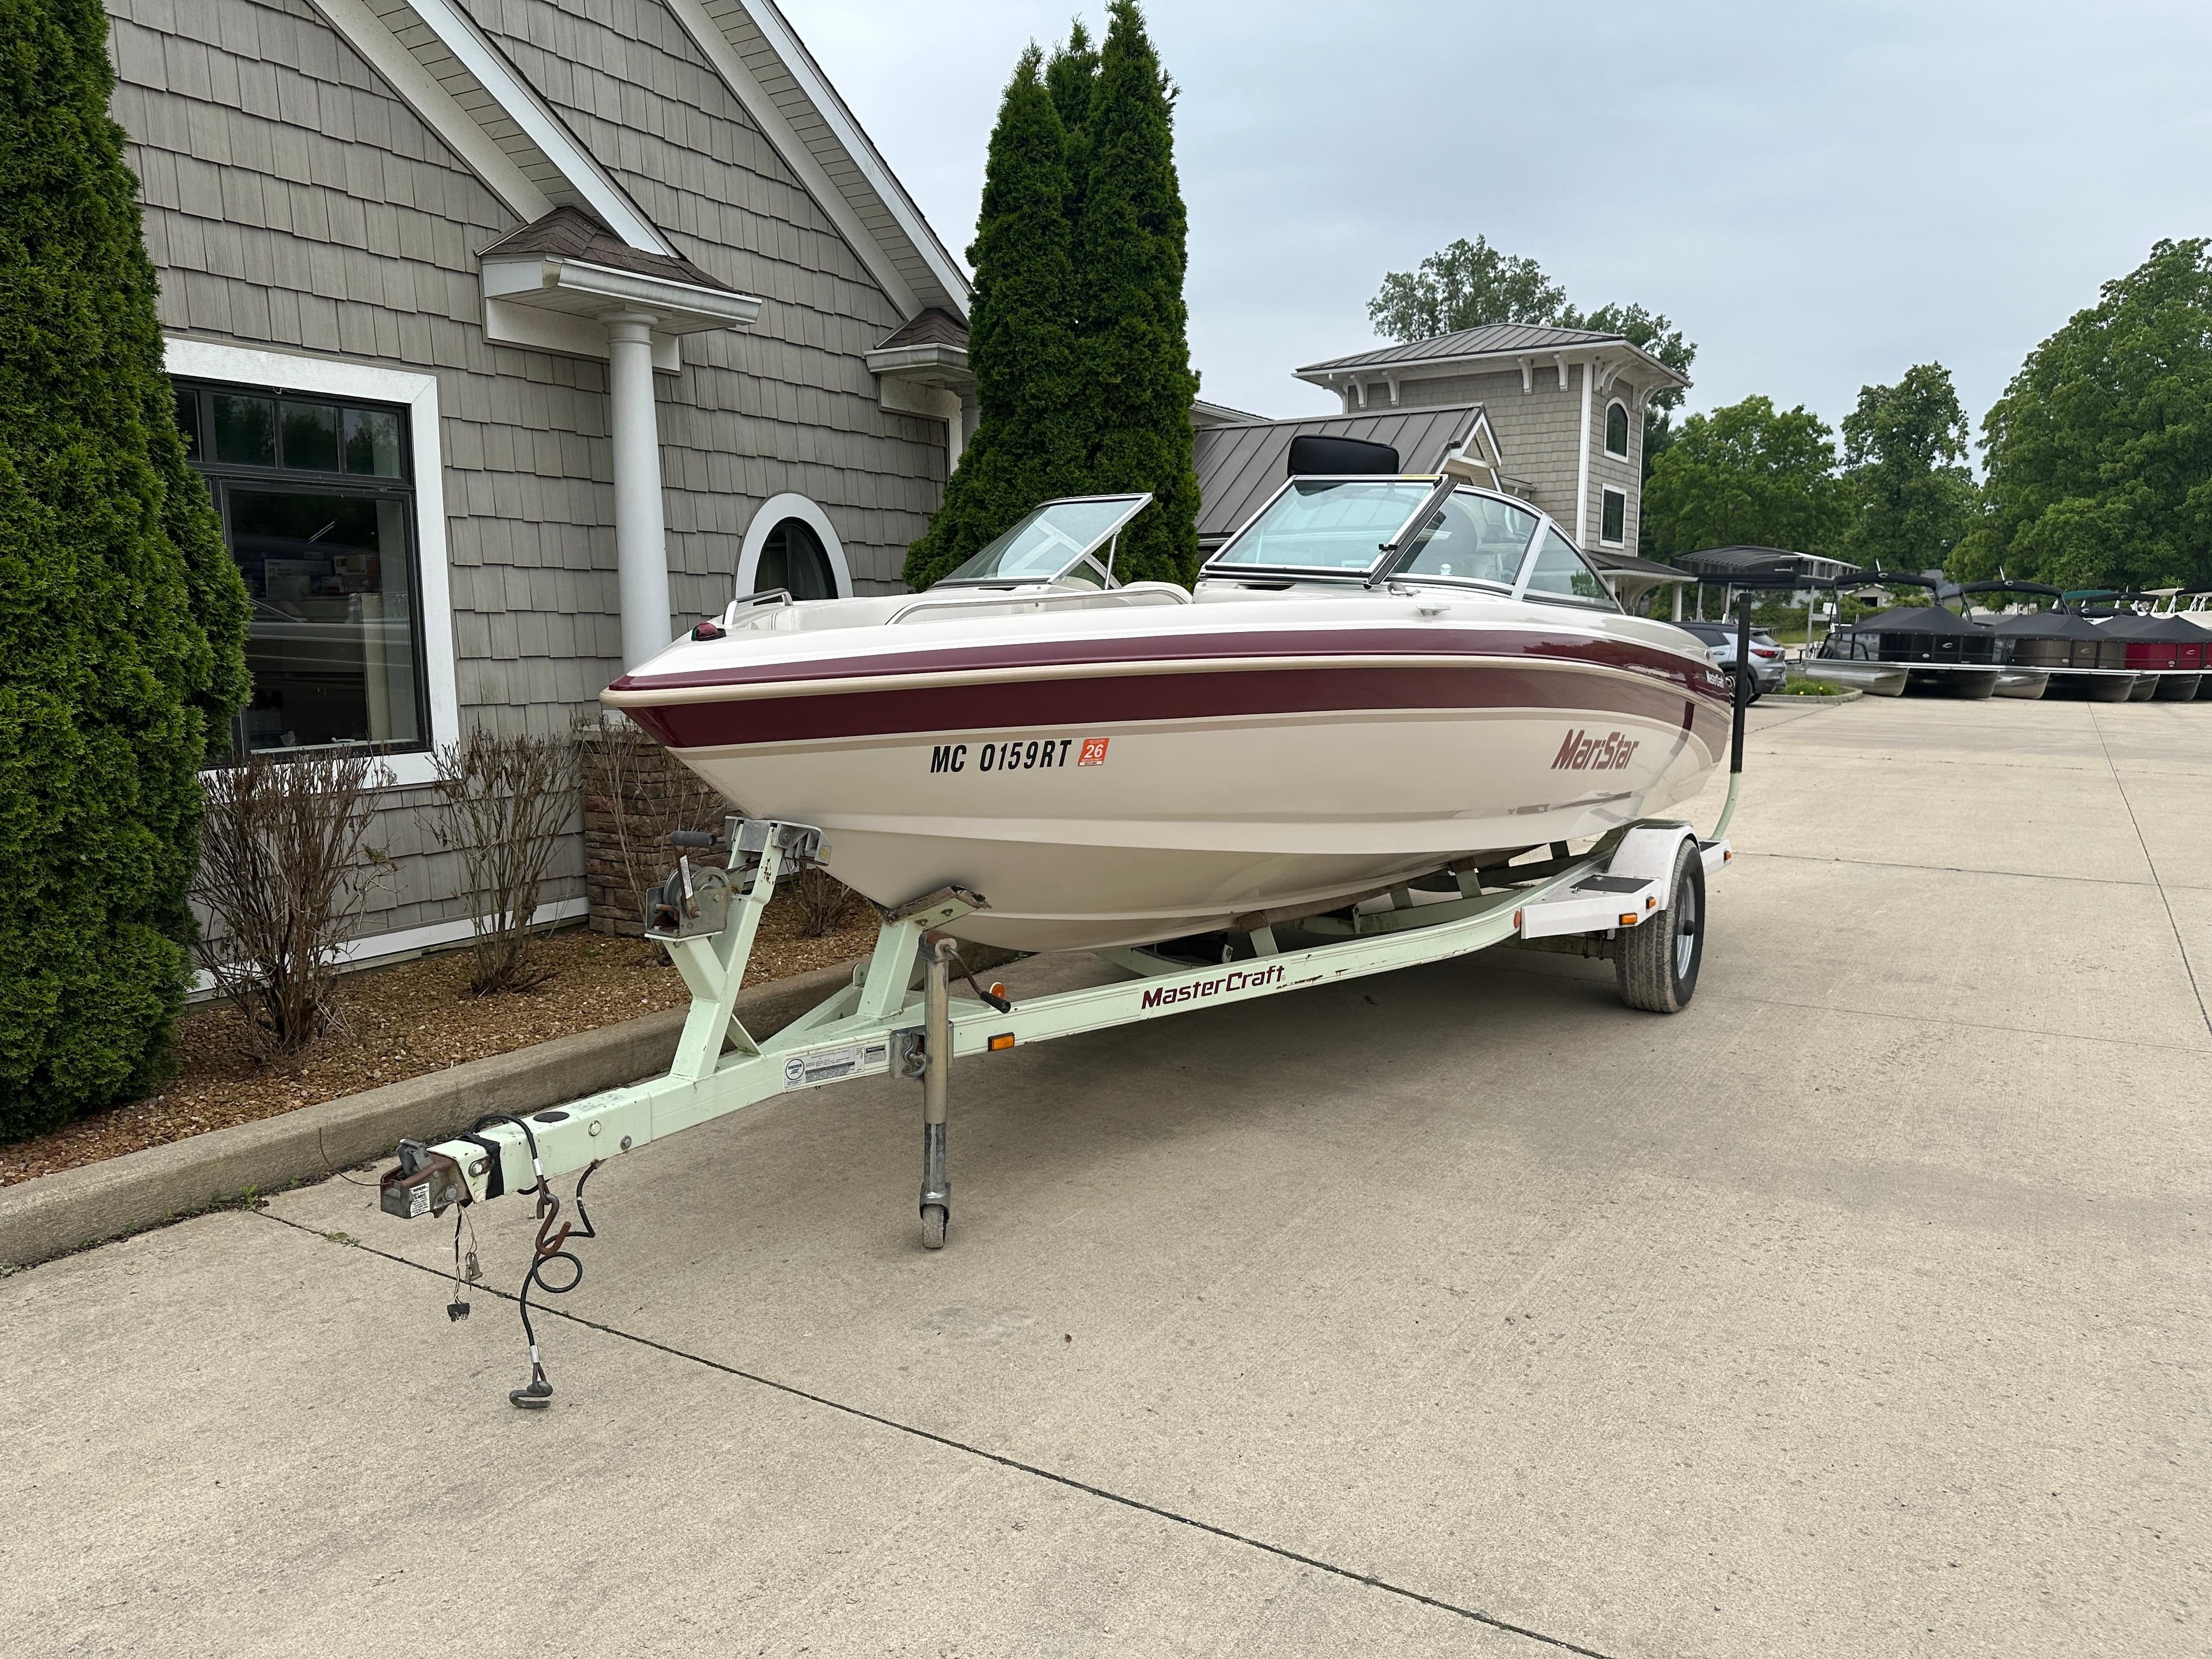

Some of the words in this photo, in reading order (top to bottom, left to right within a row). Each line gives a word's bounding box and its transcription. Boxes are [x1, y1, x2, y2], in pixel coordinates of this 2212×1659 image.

[930, 745, 967, 773] MC
[979, 739, 1073, 772] 0159RT
[1084, 744, 1104, 759] 26
[1550, 729, 1640, 770] MariStar
[1141, 965, 1285, 1009] MasterCraft
